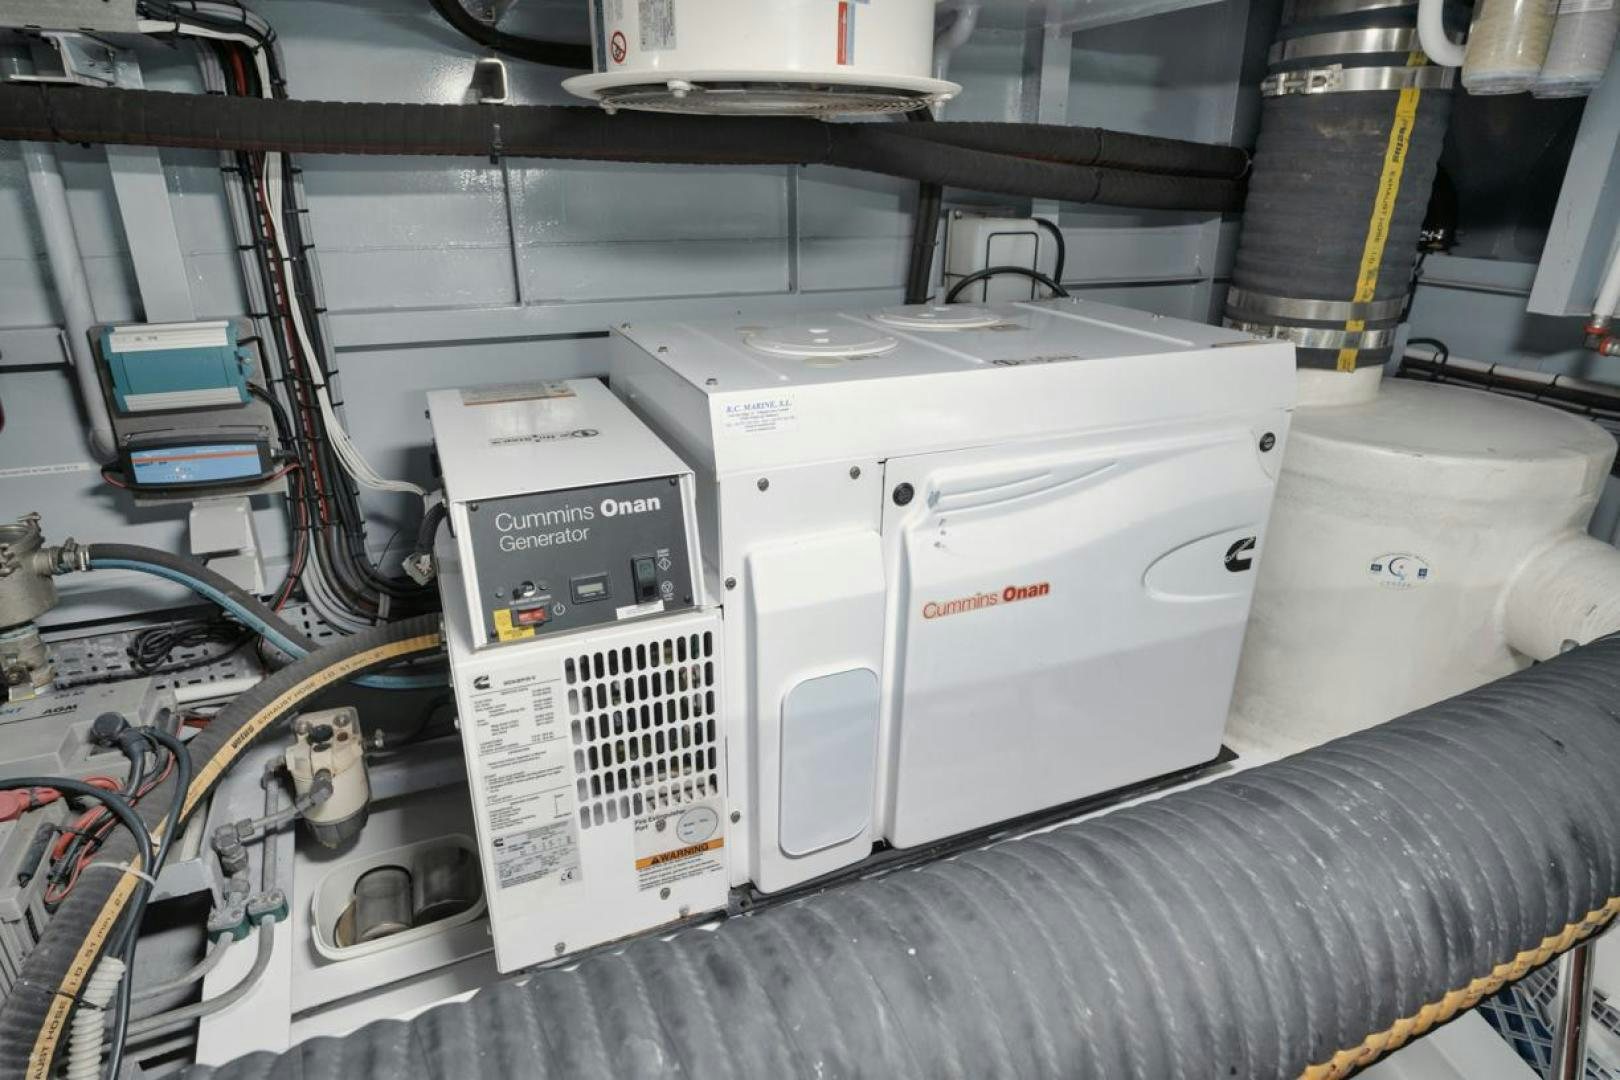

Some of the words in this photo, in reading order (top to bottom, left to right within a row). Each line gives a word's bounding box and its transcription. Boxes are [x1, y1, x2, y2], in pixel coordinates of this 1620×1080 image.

[494, 502, 595, 533] Cummins
[600, 495, 661, 519] Onan
[498, 525, 591, 553] Generator
[922, 592, 999, 620] Cummins
[1002, 581, 1050, 602] Onan
[43, 704, 78, 715] AGM
[661, 842, 709, 864] WARNING
[46, 1001, 68, 1041] HOSE
